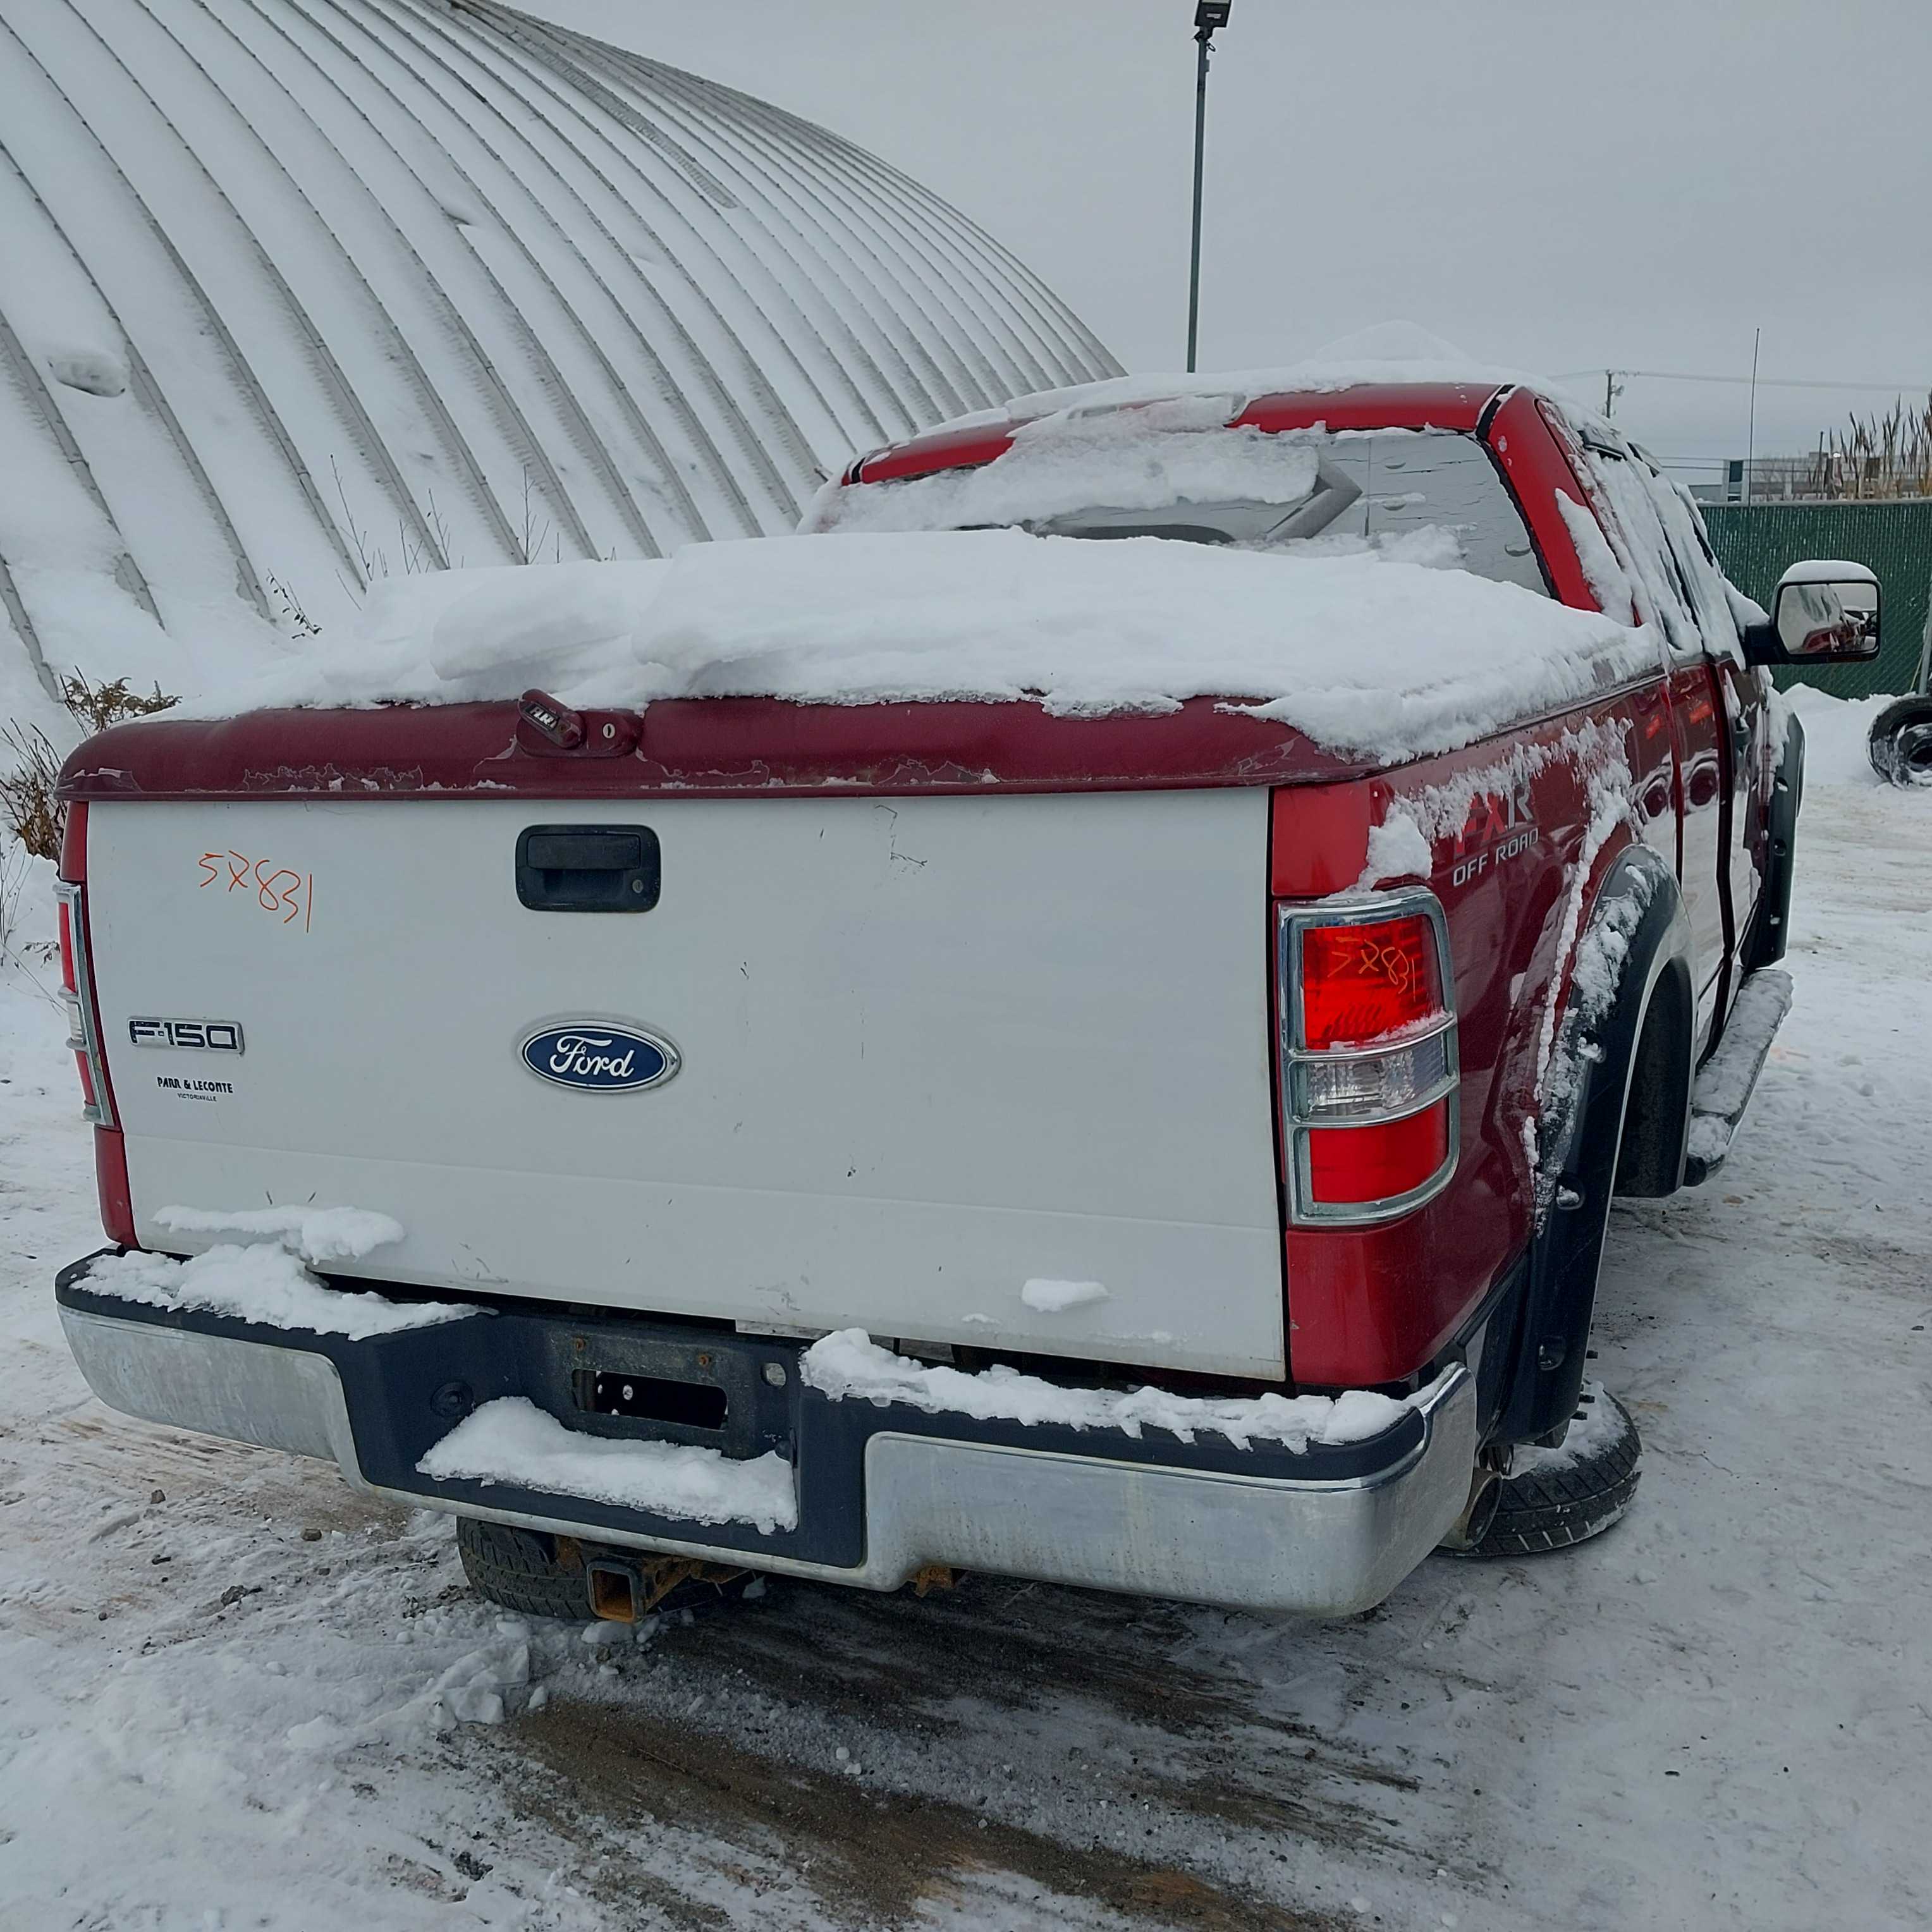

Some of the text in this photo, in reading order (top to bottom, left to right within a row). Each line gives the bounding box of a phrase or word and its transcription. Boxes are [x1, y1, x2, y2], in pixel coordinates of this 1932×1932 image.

[1453, 827, 1539, 886] OFF ROAD
[128, 1020, 238, 1050] F-150
[549, 1035, 635, 1078] Ford
[157, 1076, 234, 1094] PARR & LECONTE
[176, 1092, 217, 1103] VICTORIAVILLE
